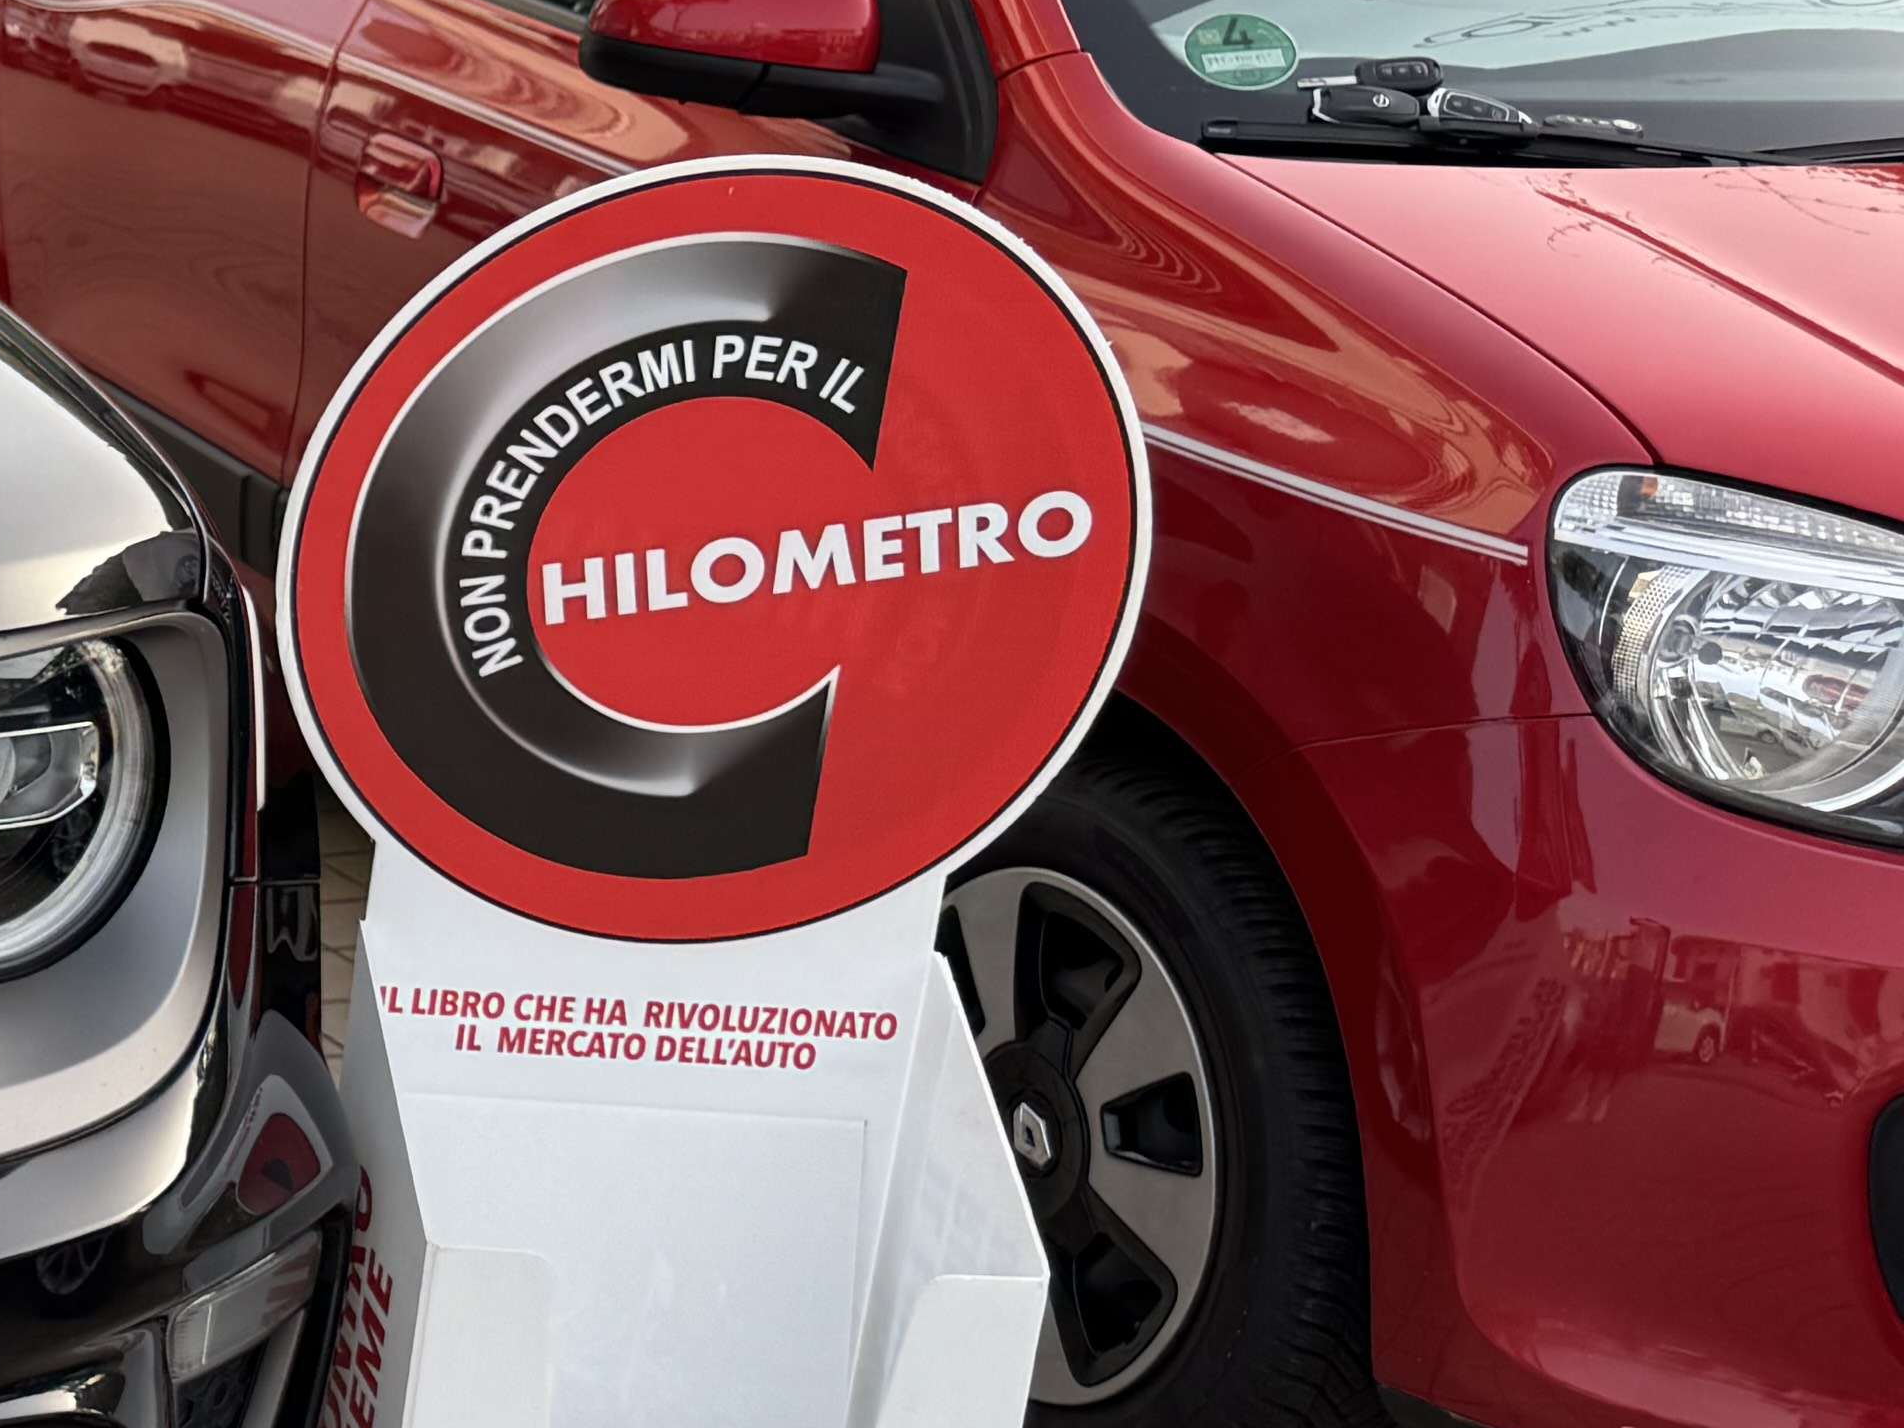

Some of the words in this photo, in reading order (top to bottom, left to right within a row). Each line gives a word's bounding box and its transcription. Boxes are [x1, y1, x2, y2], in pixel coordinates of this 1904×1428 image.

[1222, 17, 1255, 49] 4
[712, 334, 819, 390] PER
[818, 357, 865, 415] IL
[462, 339, 696, 560] PRENDERMI
[459, 574, 524, 678] NON
[410, 988, 505, 1020] LIBRO
[514, 992, 575, 1026] CHE
[583, 997, 628, 1027] HA
[644, 1000, 898, 1042] RIVOLUZIONATO
[455, 1024, 482, 1052] IL
[497, 1026, 647, 1062] MERCATO
[655, 1036, 817, 1072] DELL'AUTO
